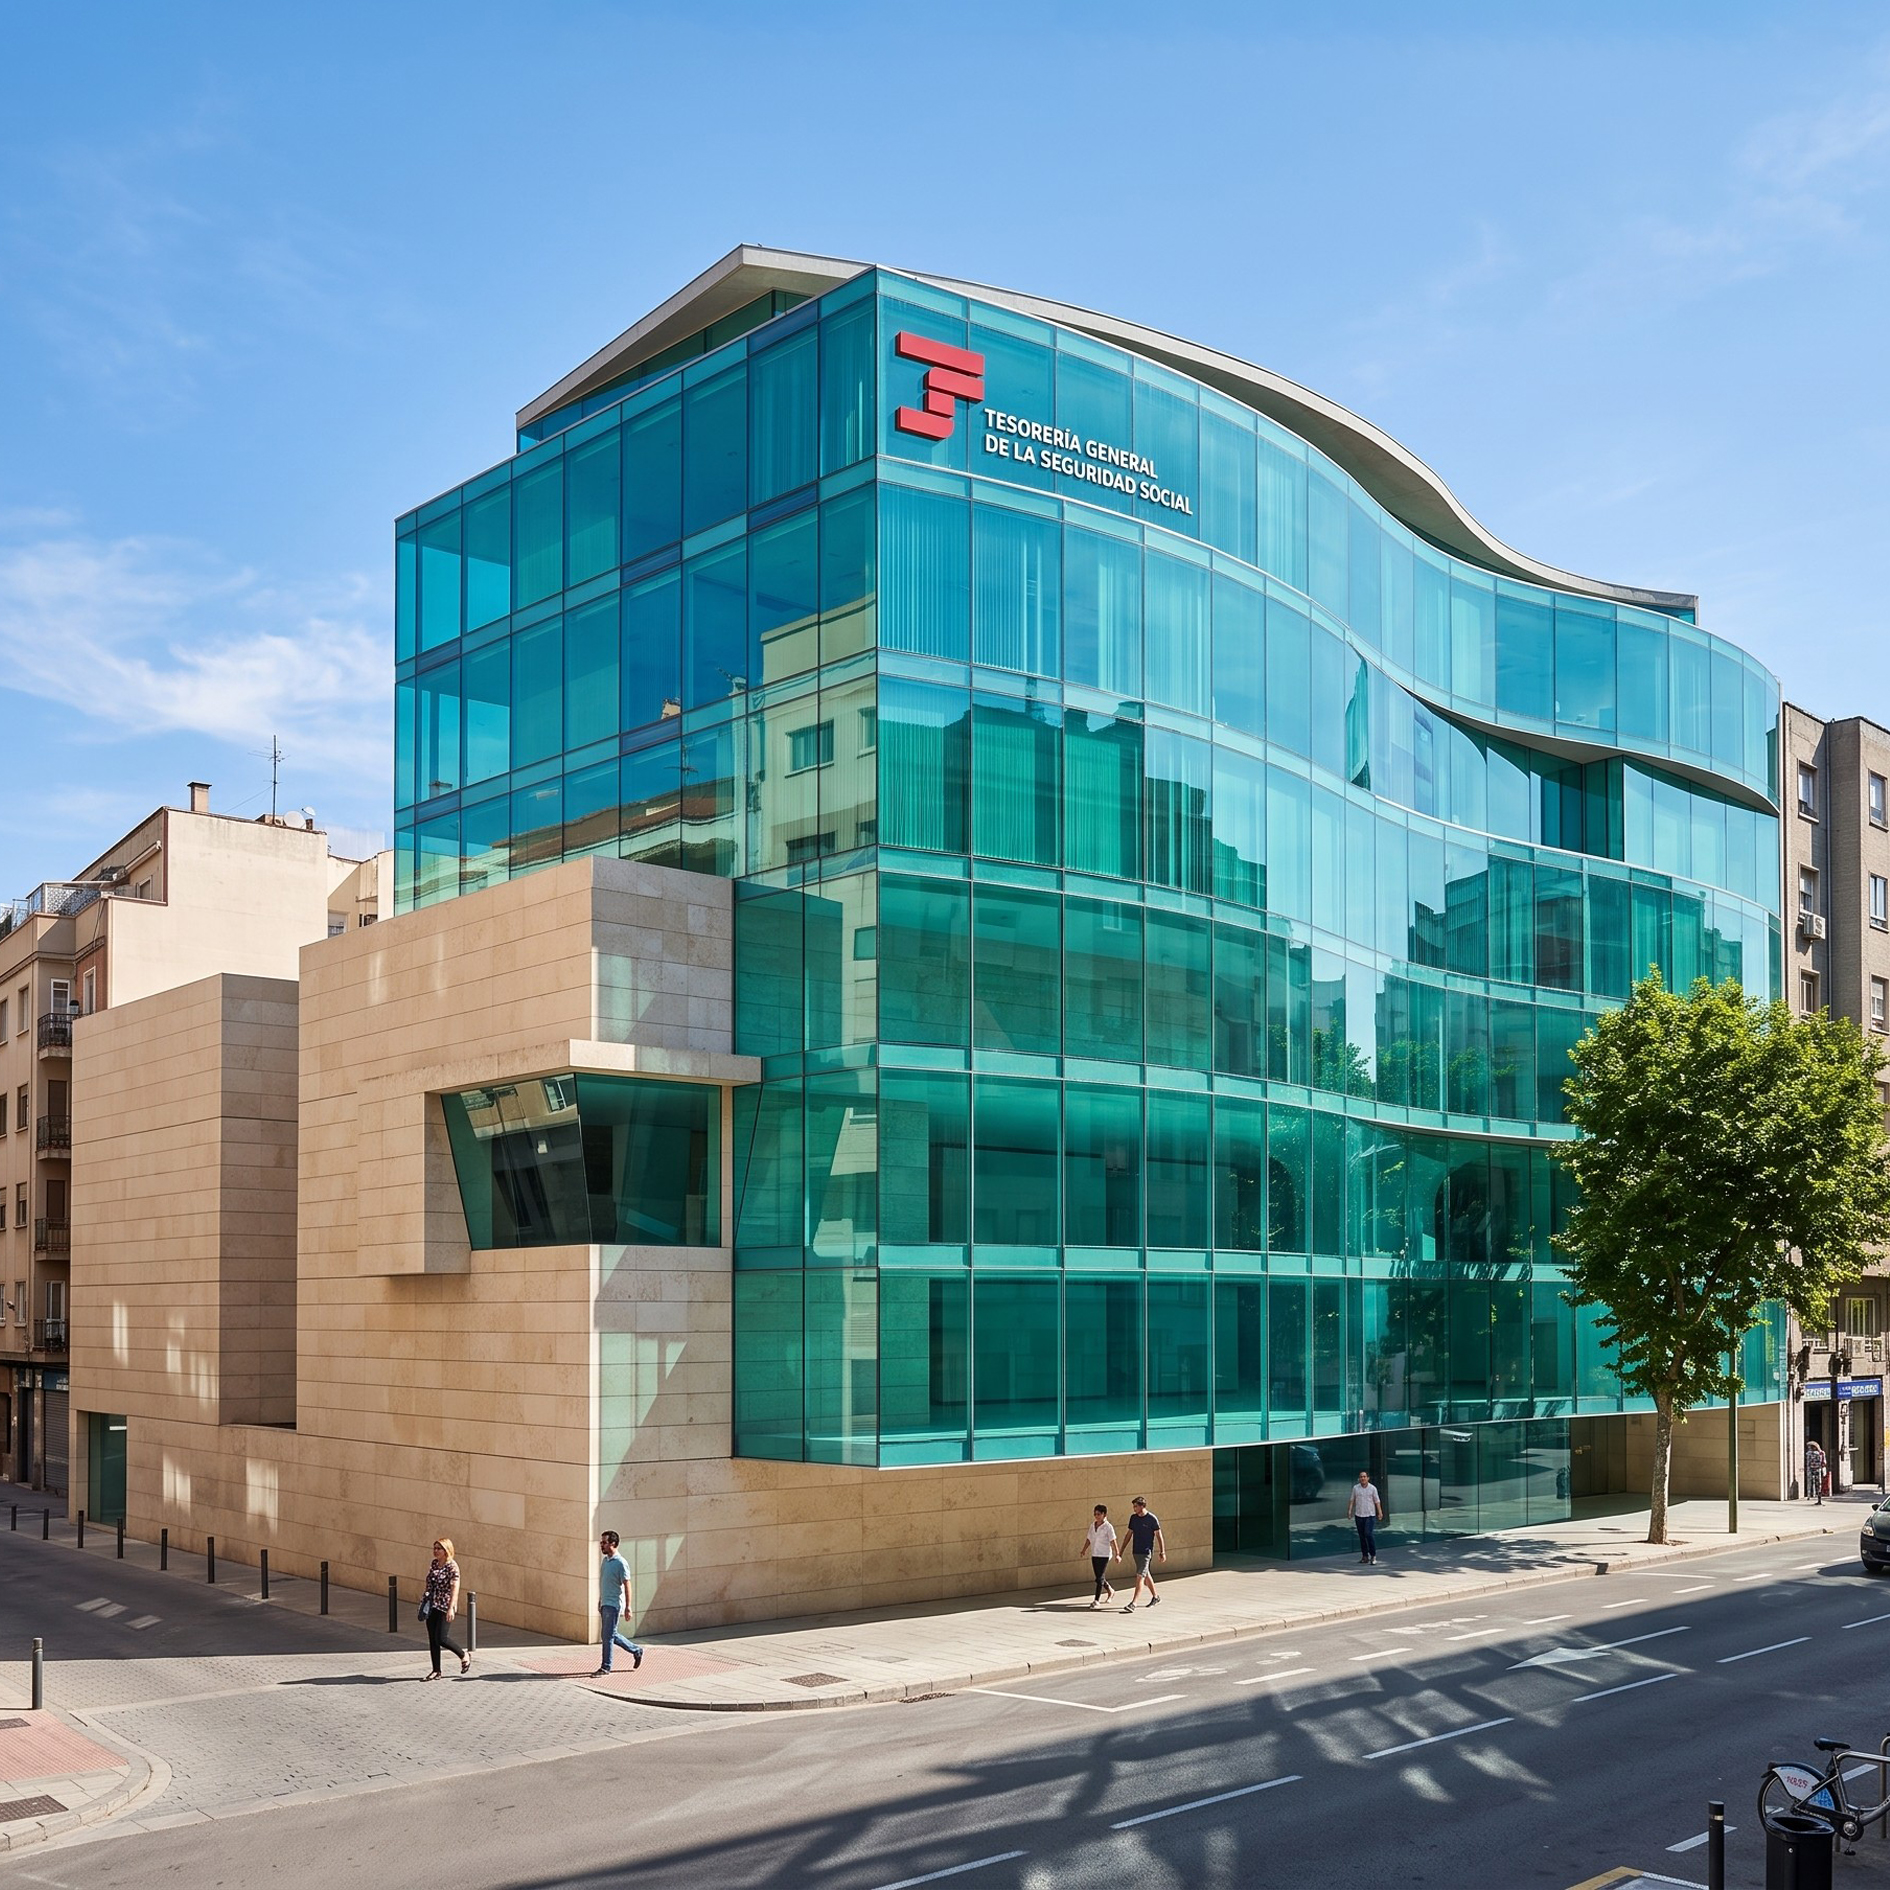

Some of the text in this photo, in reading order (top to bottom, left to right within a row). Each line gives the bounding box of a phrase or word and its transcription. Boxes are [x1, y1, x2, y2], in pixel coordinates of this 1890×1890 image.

[984, 408, 1158, 479] TESORERÍA GENERAL
[985, 433, 1193, 515] DE LA SEGURIDAD SOCIAL
